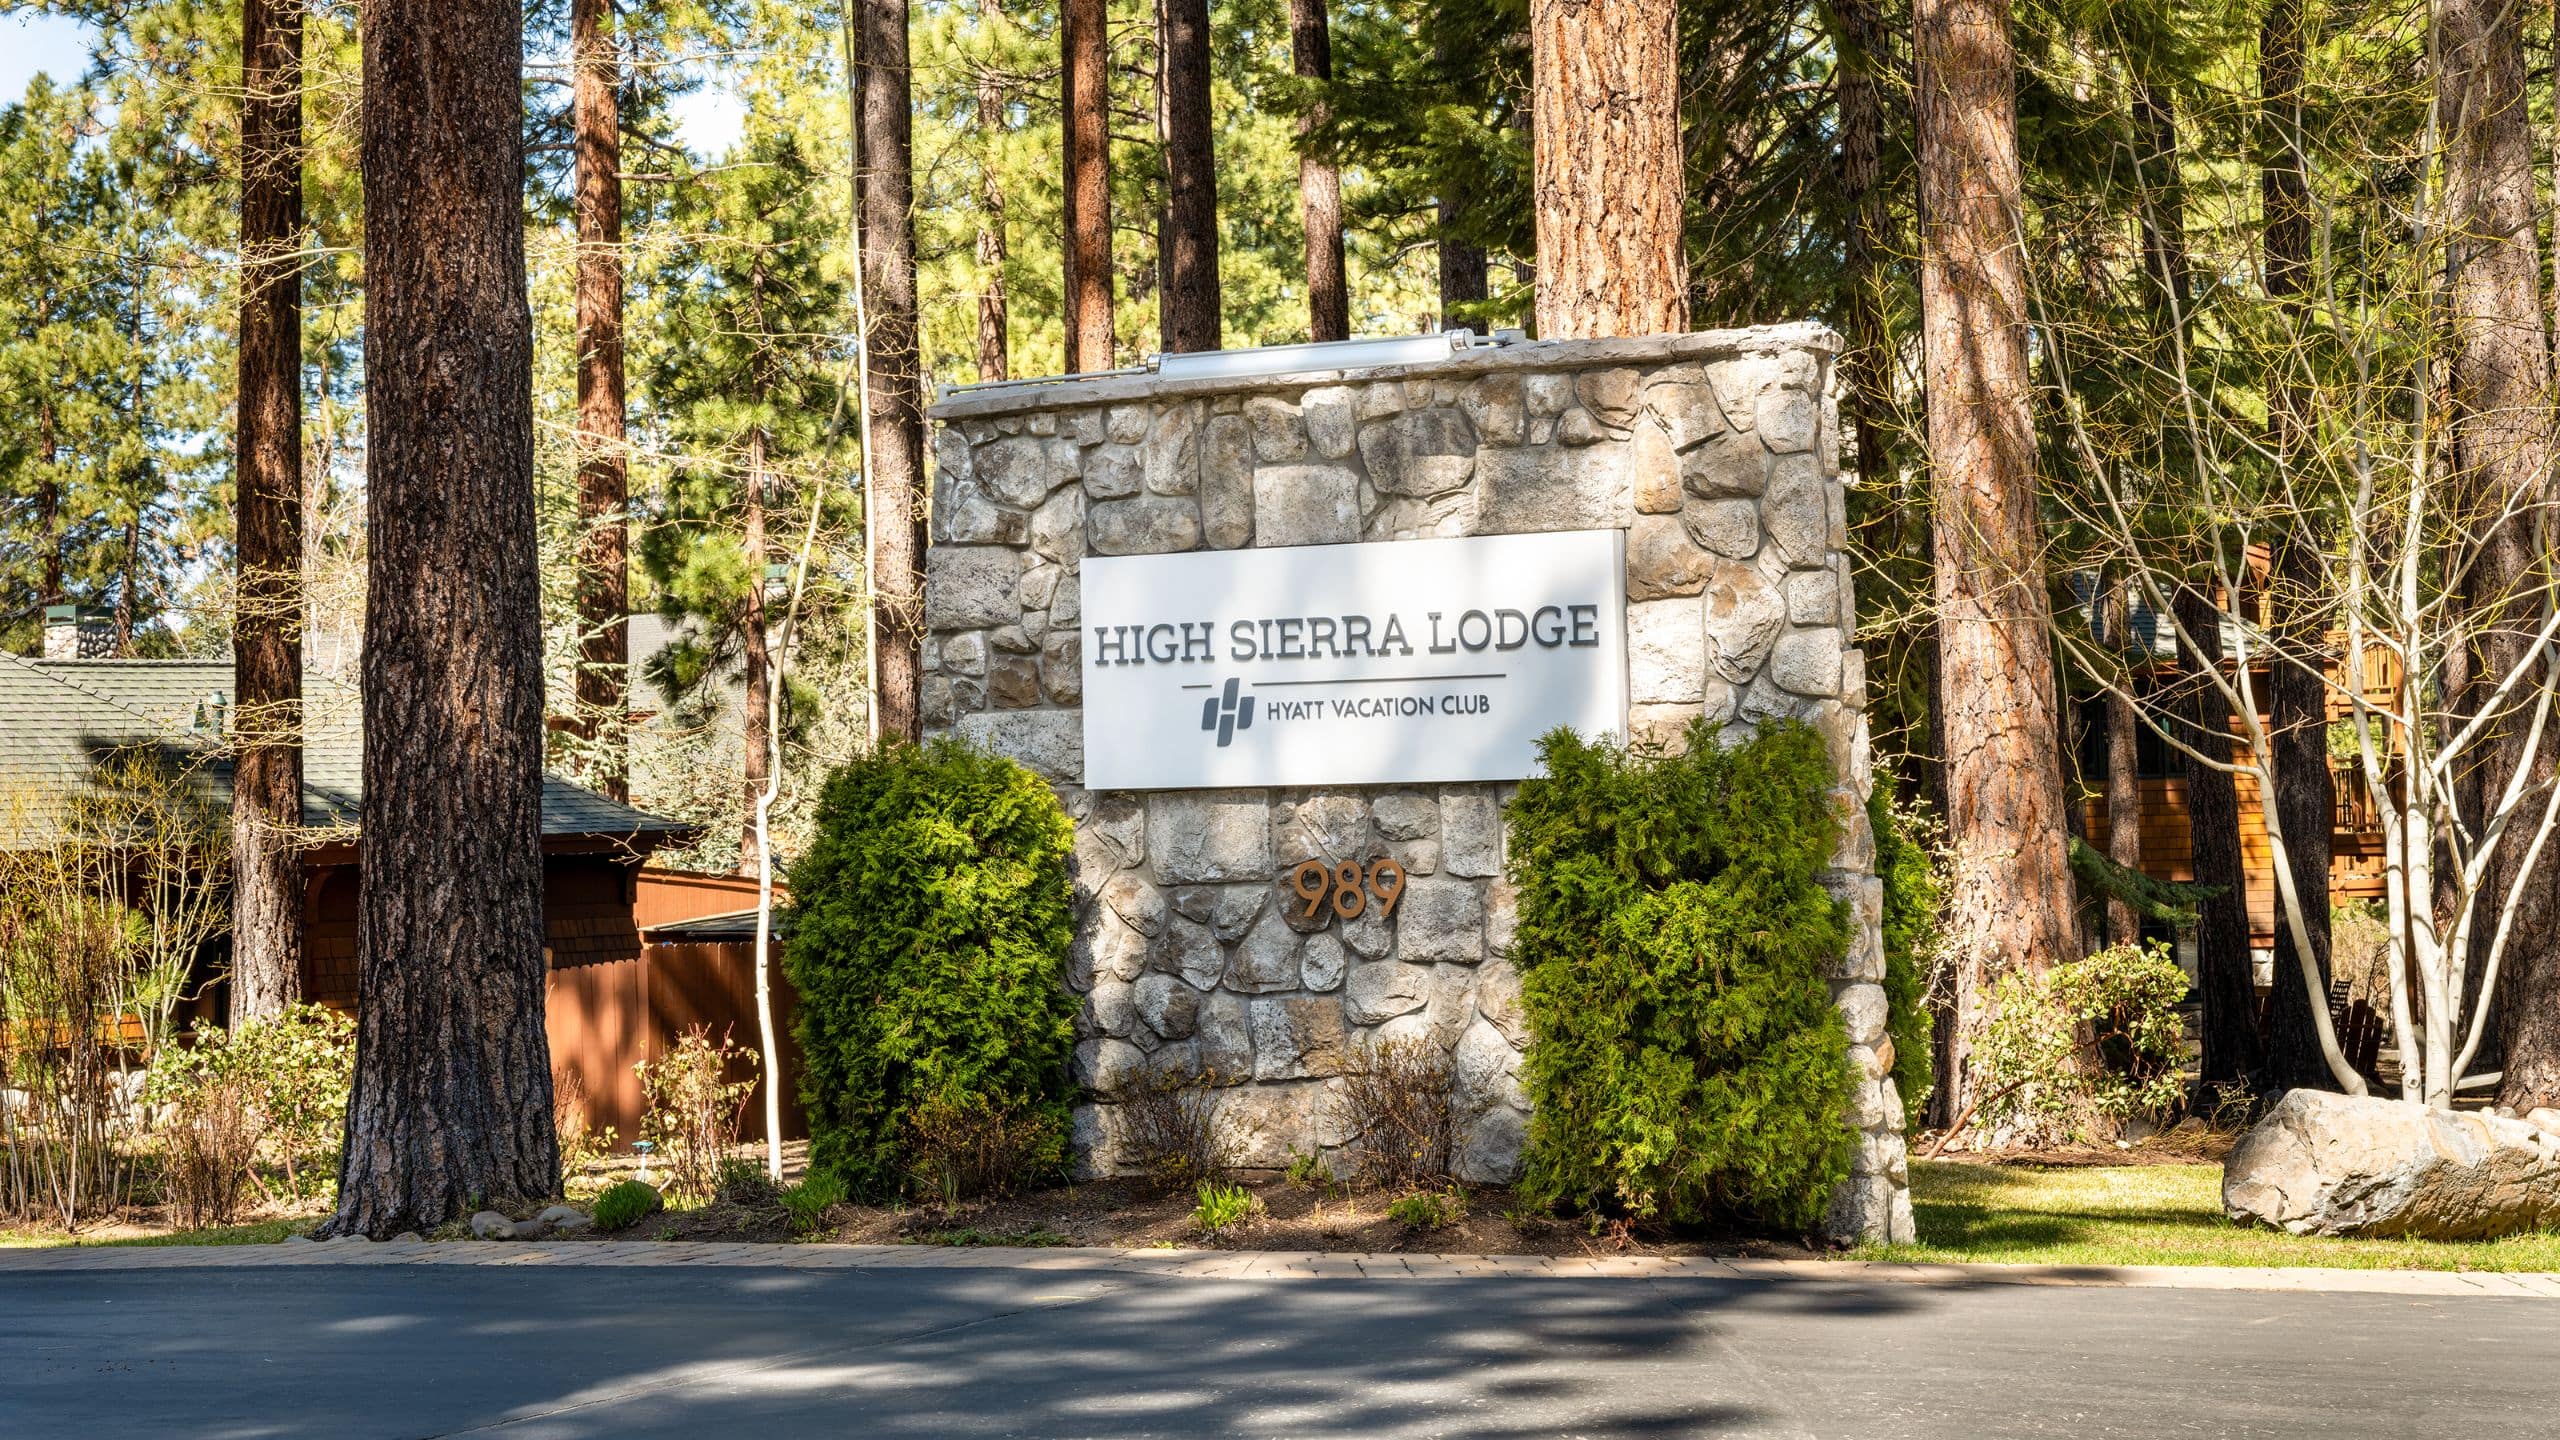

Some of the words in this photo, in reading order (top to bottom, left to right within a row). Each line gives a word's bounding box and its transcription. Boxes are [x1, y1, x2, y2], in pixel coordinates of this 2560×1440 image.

[1094, 621, 1216, 666] HIGH
[1230, 613, 1414, 662] SIERRA
[1427, 604, 1600, 654] LODGE
[1267, 699, 1325, 721] HYATT
[1331, 695, 1435, 718] VACATION
[1440, 693, 1491, 715] CLUB
[1292, 858, 1407, 919] 989
